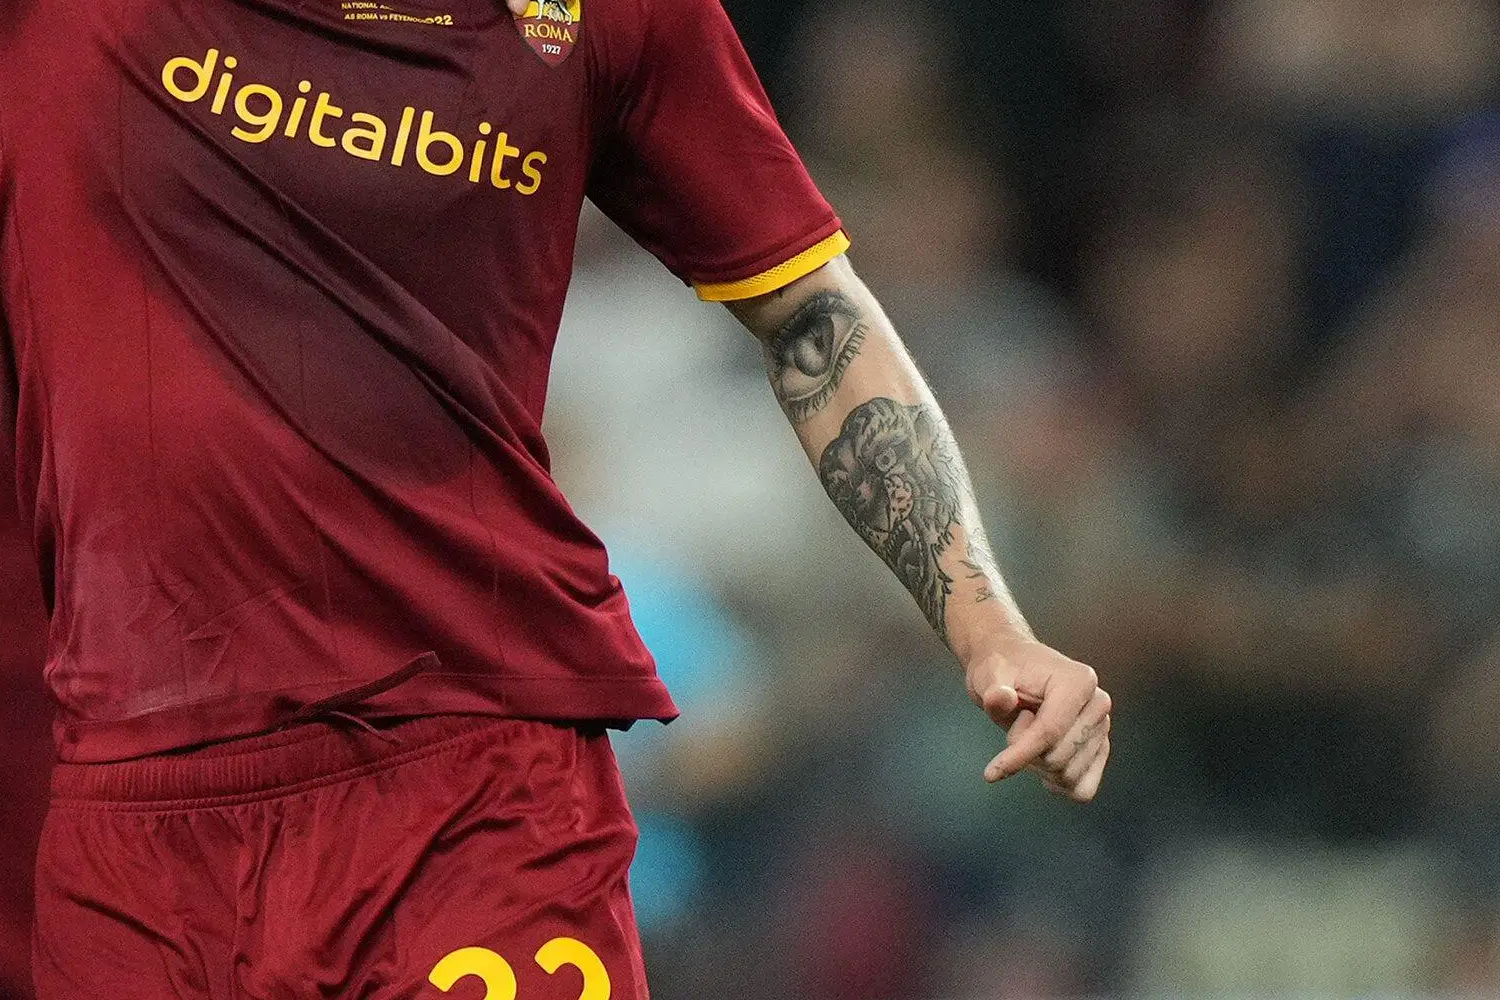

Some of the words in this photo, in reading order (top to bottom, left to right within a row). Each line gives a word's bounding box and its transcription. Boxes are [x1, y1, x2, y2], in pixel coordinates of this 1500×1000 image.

[524, 23, 574, 43] ROMA
[542, 43, 562, 55] 1927
[161, 48, 548, 195] digitalbits
